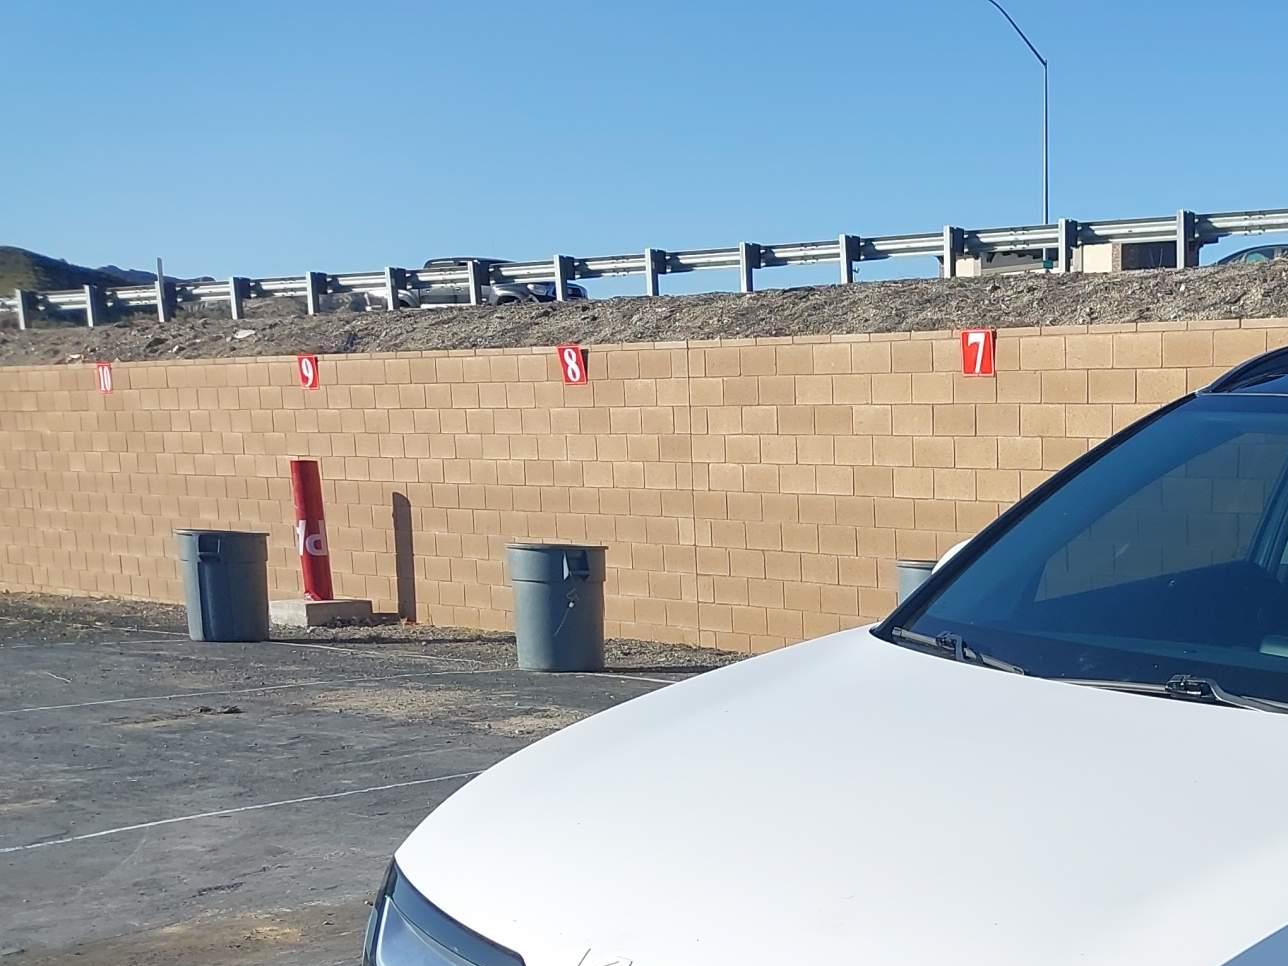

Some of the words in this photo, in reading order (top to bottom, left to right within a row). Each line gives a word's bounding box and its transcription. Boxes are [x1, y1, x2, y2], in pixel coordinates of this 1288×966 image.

[563, 348, 580, 382] 8
[967, 332, 985, 373] 7
[98, 365, 112, 391] 10
[301, 358, 313, 387] 9
